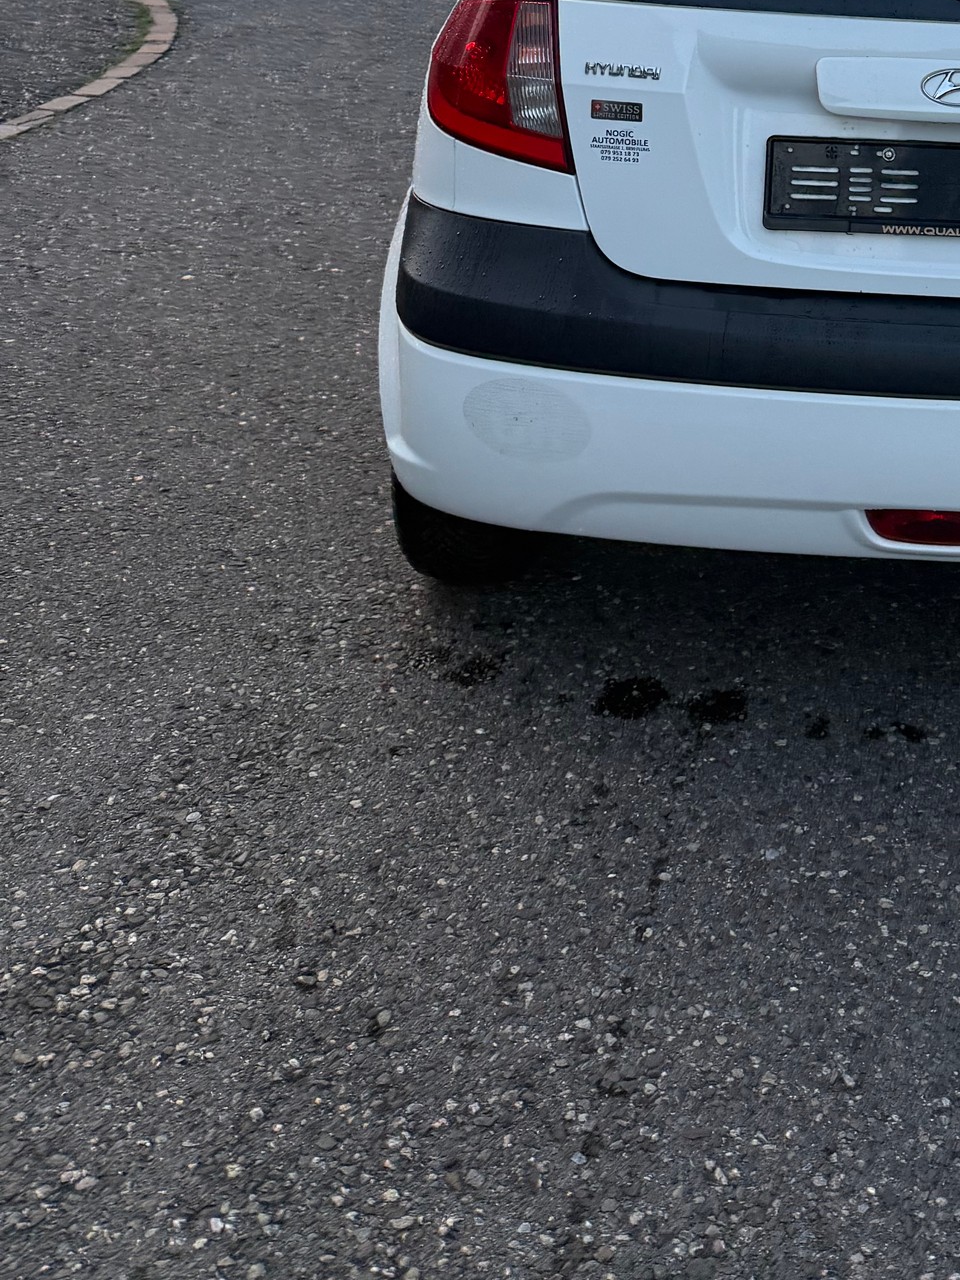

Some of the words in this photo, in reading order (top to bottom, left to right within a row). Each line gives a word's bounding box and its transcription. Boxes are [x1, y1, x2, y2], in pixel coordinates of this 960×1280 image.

[585, 61, 661, 80] HYUNDAI
[603, 103, 640, 115] SWISS
[605, 129, 634, 138] NOGIC
[592, 136, 648, 146] AUTOMOBILE
